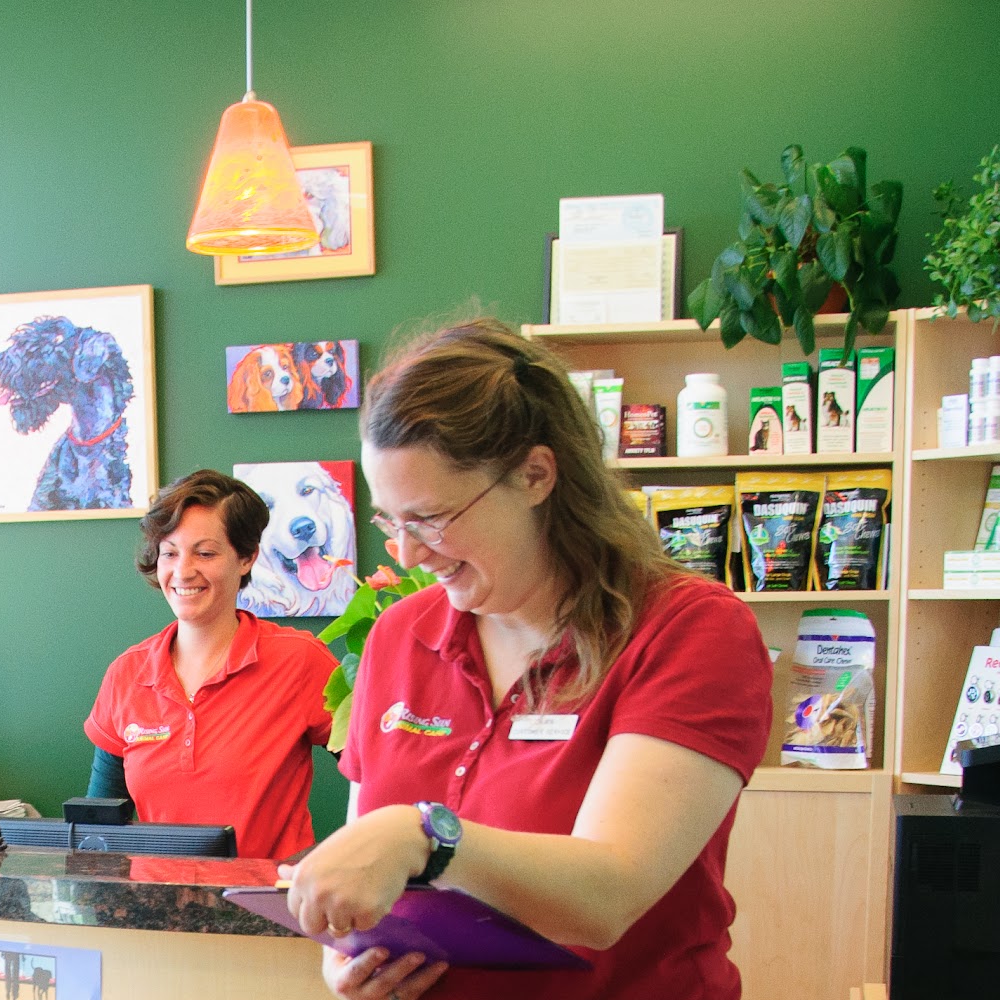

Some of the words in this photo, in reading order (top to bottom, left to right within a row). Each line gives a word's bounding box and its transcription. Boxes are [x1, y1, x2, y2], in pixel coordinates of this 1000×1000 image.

[753, 502, 808, 516] DASUQUIN
[824, 499, 878, 515] DASUQUIN
[672, 514, 720, 528] DASUQUIN
[985, 657, 1000, 668] Re
